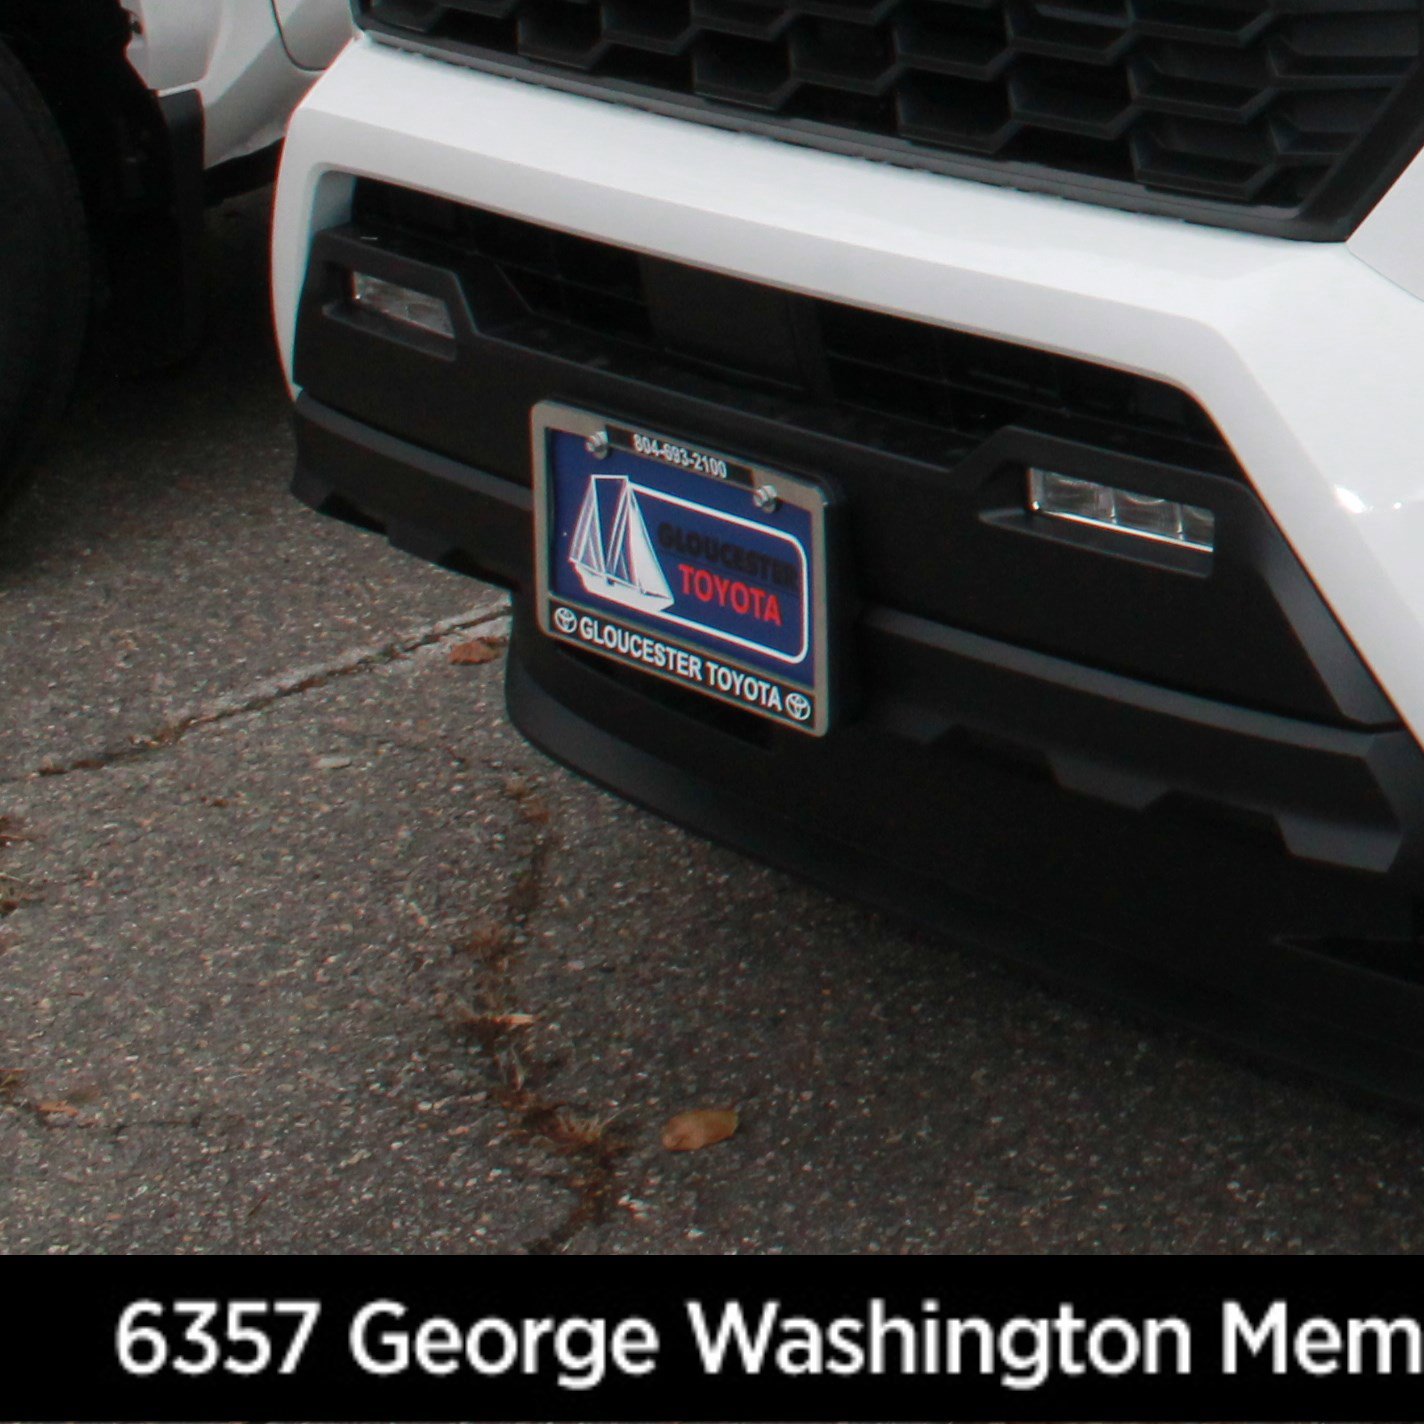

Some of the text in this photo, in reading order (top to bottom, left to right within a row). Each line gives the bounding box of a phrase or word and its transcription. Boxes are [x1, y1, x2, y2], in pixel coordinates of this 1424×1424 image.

[632, 433, 728, 479] 804-693-2100
[656, 521, 800, 588] GLOUCESTER
[678, 563, 783, 627] TOYOTA
[579, 615, 783, 713] GLOUCESTER TOYOTA
